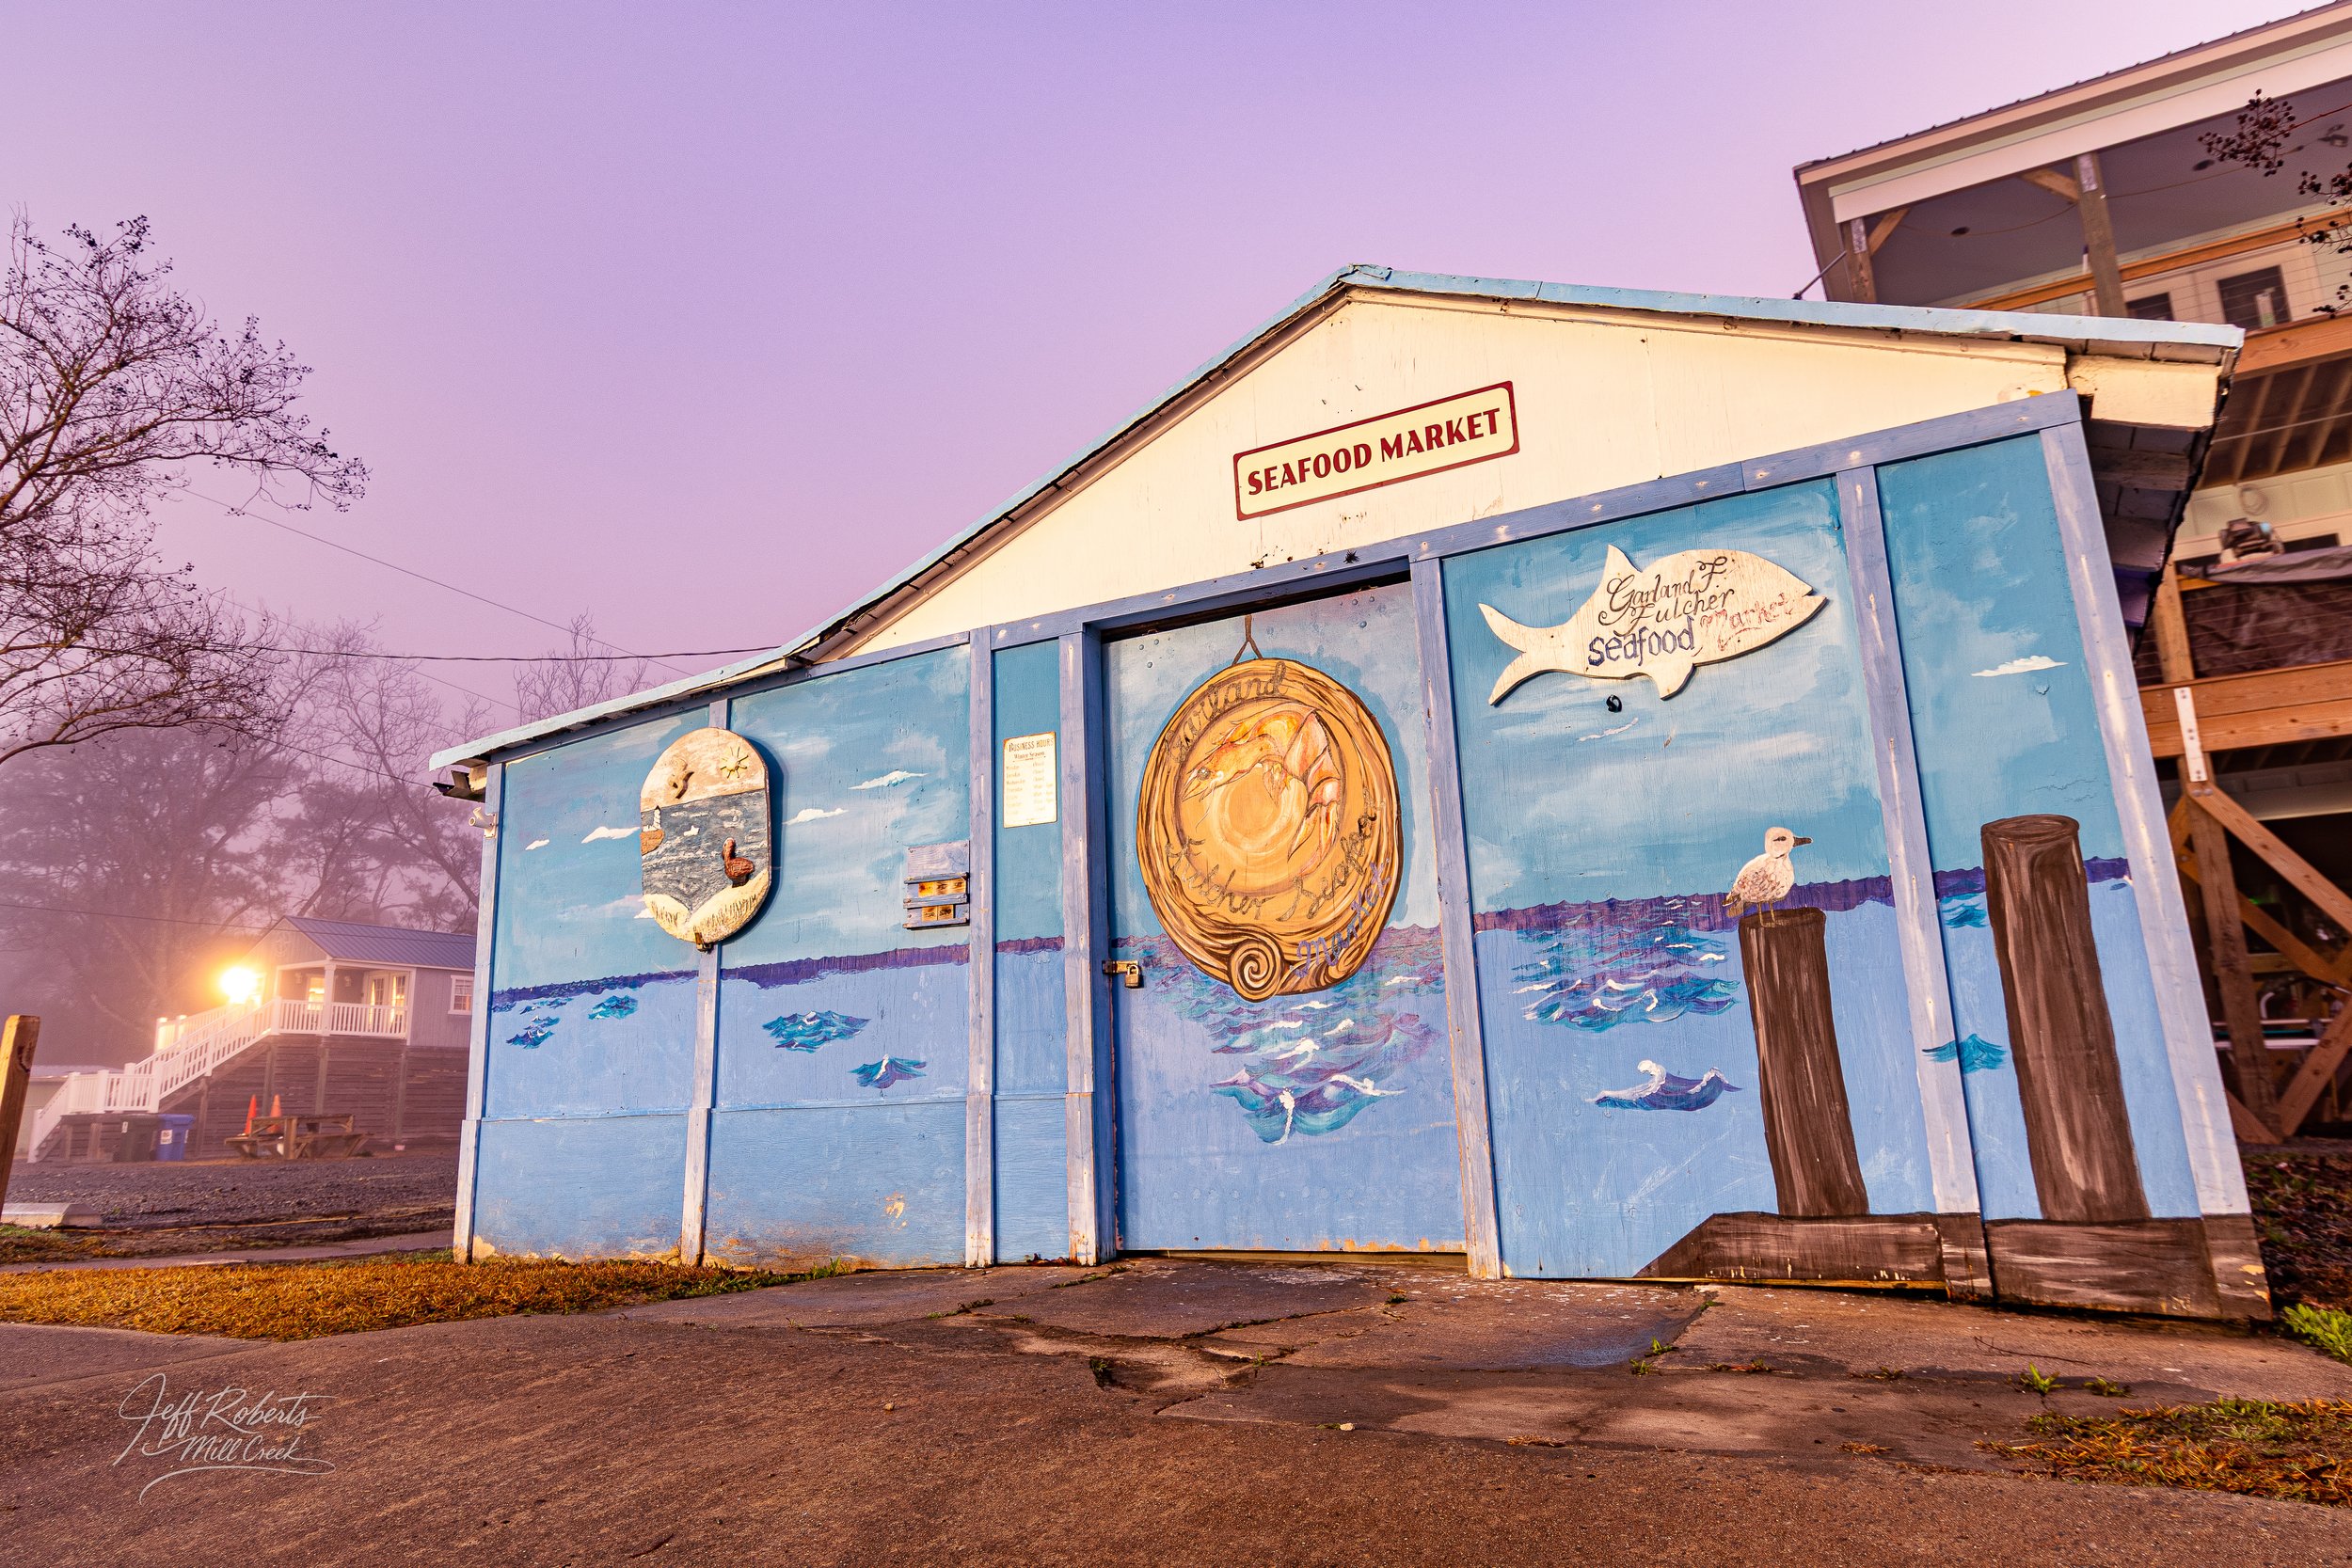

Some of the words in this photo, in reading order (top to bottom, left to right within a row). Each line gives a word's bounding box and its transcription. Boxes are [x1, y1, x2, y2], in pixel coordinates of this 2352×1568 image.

[1248, 443, 1373, 496] SEAFOOD
[1380, 407, 1501, 463] MARKET
[1598, 569, 1695, 626] Garland
[1613, 588, 1735, 637] Fulcher
